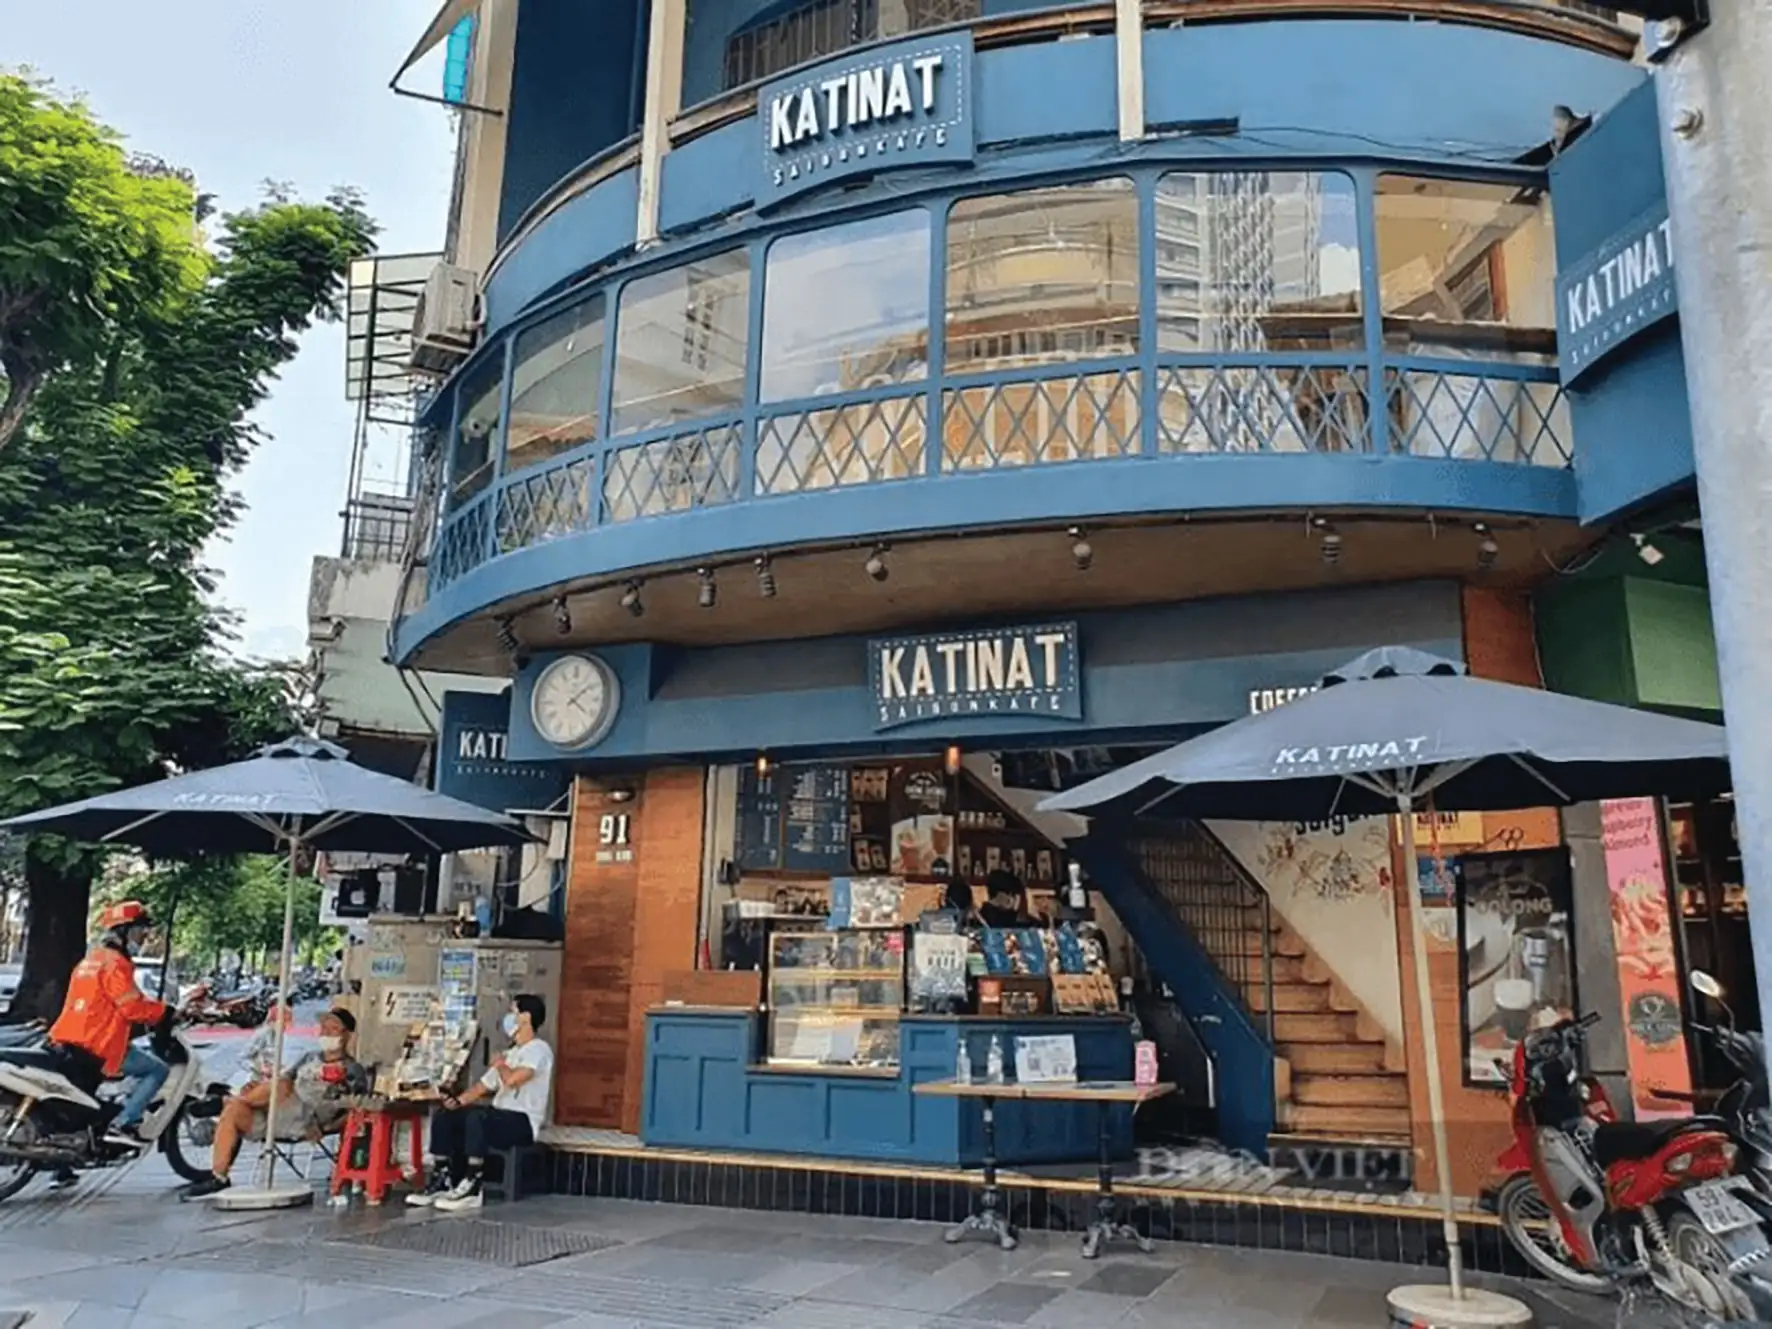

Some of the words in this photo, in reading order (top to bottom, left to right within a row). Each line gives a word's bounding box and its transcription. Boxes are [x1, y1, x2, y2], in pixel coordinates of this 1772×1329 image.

[770, 54, 943, 150] KATINAT
[1567, 218, 1674, 333] KATINAT
[880, 633, 1065, 699] KATINAT
[459, 731, 508, 759] KATI
[1275, 735, 1428, 764] KATINAT
[599, 815, 630, 844] 91
